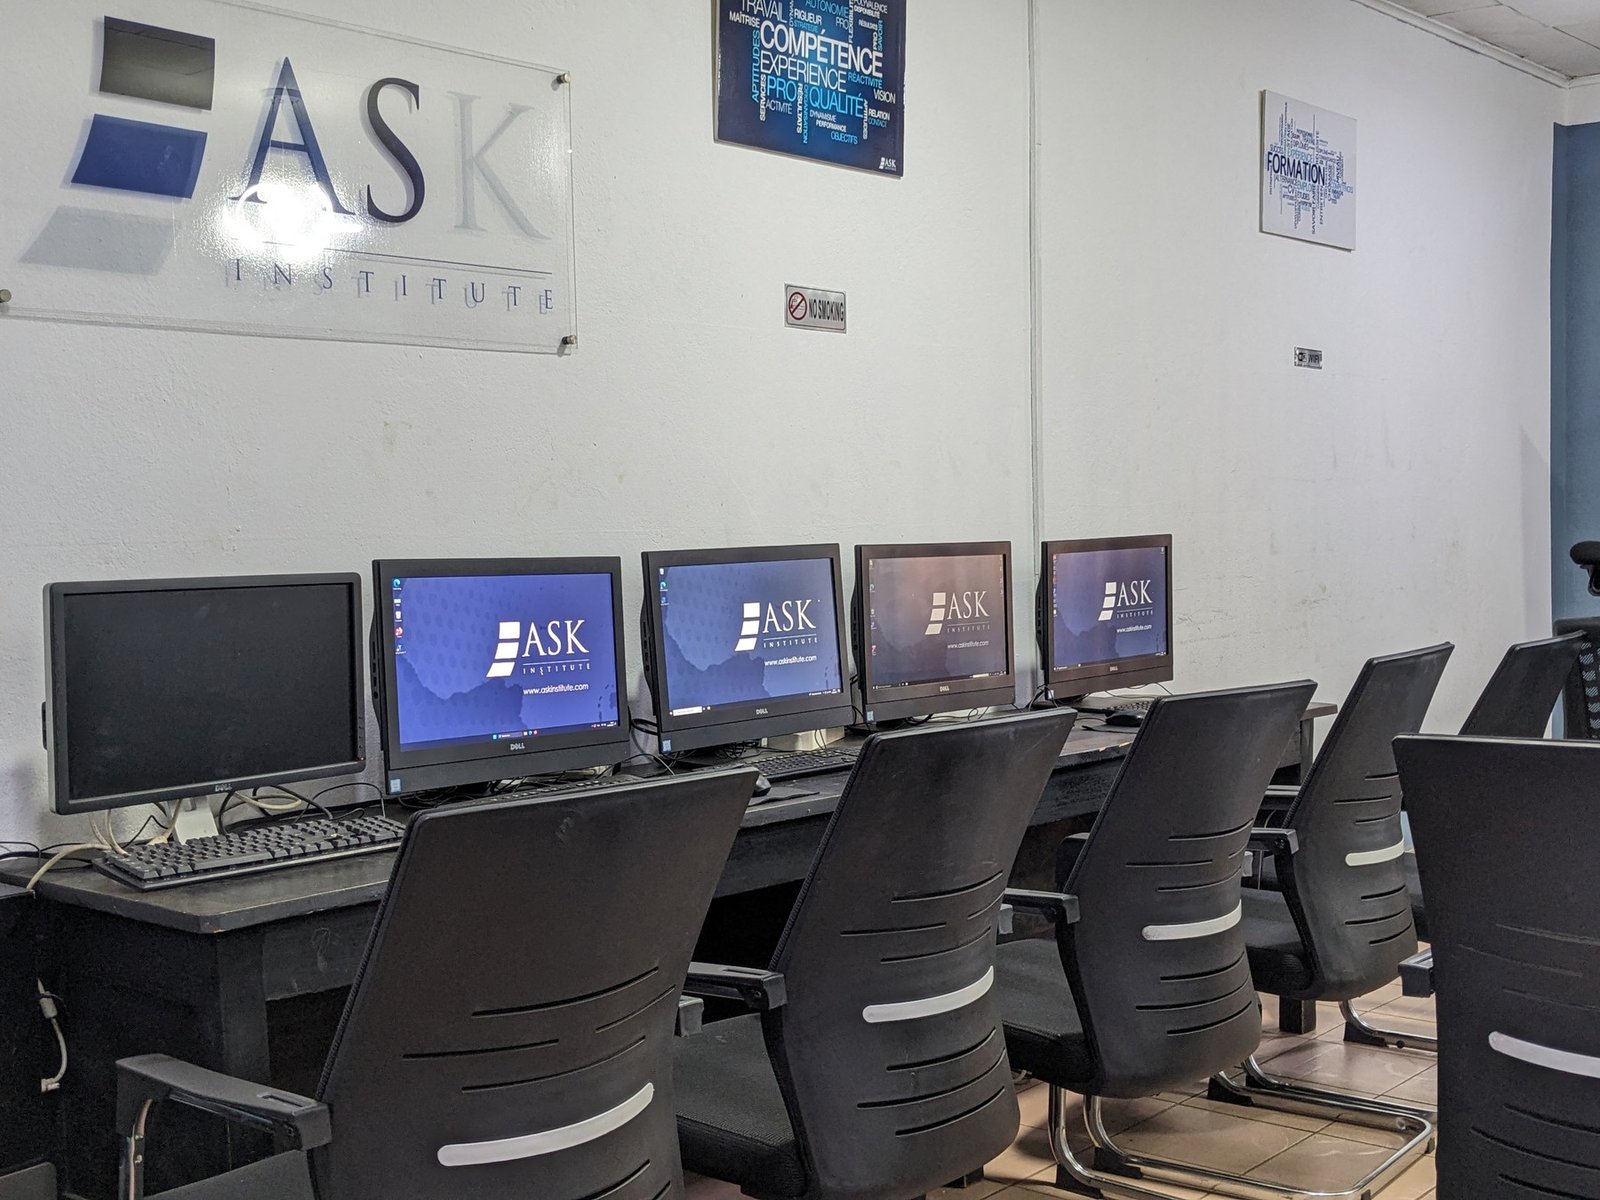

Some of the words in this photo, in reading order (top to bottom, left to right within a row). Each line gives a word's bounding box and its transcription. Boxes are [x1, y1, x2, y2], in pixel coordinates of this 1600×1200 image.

[729, 11, 760, 28] MAÎTRISE
[794, 9, 822, 25] RIGUEUR
[761, 20, 883, 78] COMPÉTENCE
[752, 30, 760, 103] APTITUDES
[761, 50, 847, 92] EXPÉRIENCE
[767, 75, 797, 102] PRO
[848, 72, 882, 89] RÉACTIVITÉ
[809, 87, 863, 118] QUALITÉ
[873, 88, 896, 104] VISION
[766, 99, 793, 115] ACTIVITÉ
[868, 108, 890, 121] RELATION
[810, 109, 837, 122] DYNAMISME
[816, 120, 847, 133] PERFORMANCE
[830, 131, 858, 145] OBJECTIFS
[228, 57, 550, 239] ASK
[885, 157, 896, 168] ASK
[1267, 151, 1324, 186] FORMATION
[233, 258, 553, 310] INSTITUTE
[808, 298, 817, 319] NO
[818, 299, 844, 322] SMOKING
[1116, 580, 1153, 607] ASK
[947, 591, 990, 620] ASK
[762, 599, 816, 634] ASK
[522, 619, 590, 657] ASK
[763, 637, 818, 649] INSTITUTE
[764, 654, 817, 667] www.askinstitute.com
[523, 663, 590, 675] INSTITUTE
[522, 683, 589, 696] www.askinstitute.com
[755, 707, 769, 716] DELL
[510, 742, 526, 751] DELL
[215, 783, 233, 792] DELL
